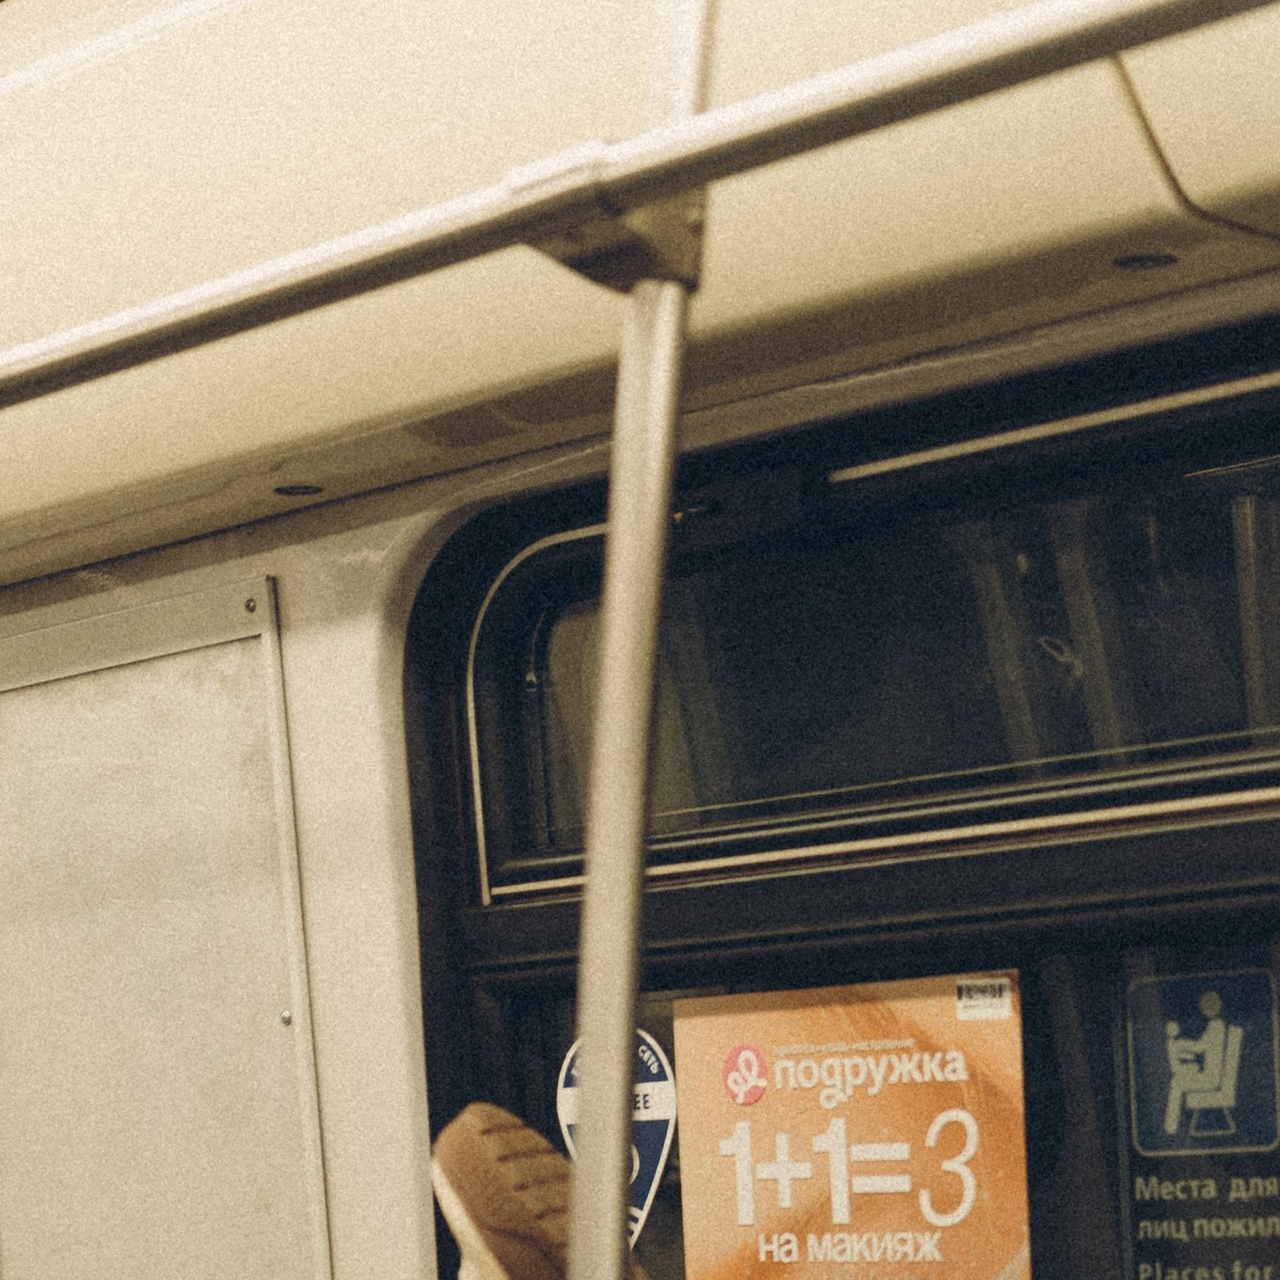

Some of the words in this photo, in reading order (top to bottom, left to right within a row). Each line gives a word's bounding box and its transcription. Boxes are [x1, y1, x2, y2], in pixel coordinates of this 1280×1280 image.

[774, 1050, 968, 1110] подружка
[1135, 1176, 1218, 1200] Места
[1228, 1176, 1279, 1203] для
[1138, 1219, 1188, 1243] лиц
[758, 1232, 799, 1263] на
[807, 1231, 944, 1262] макияж
